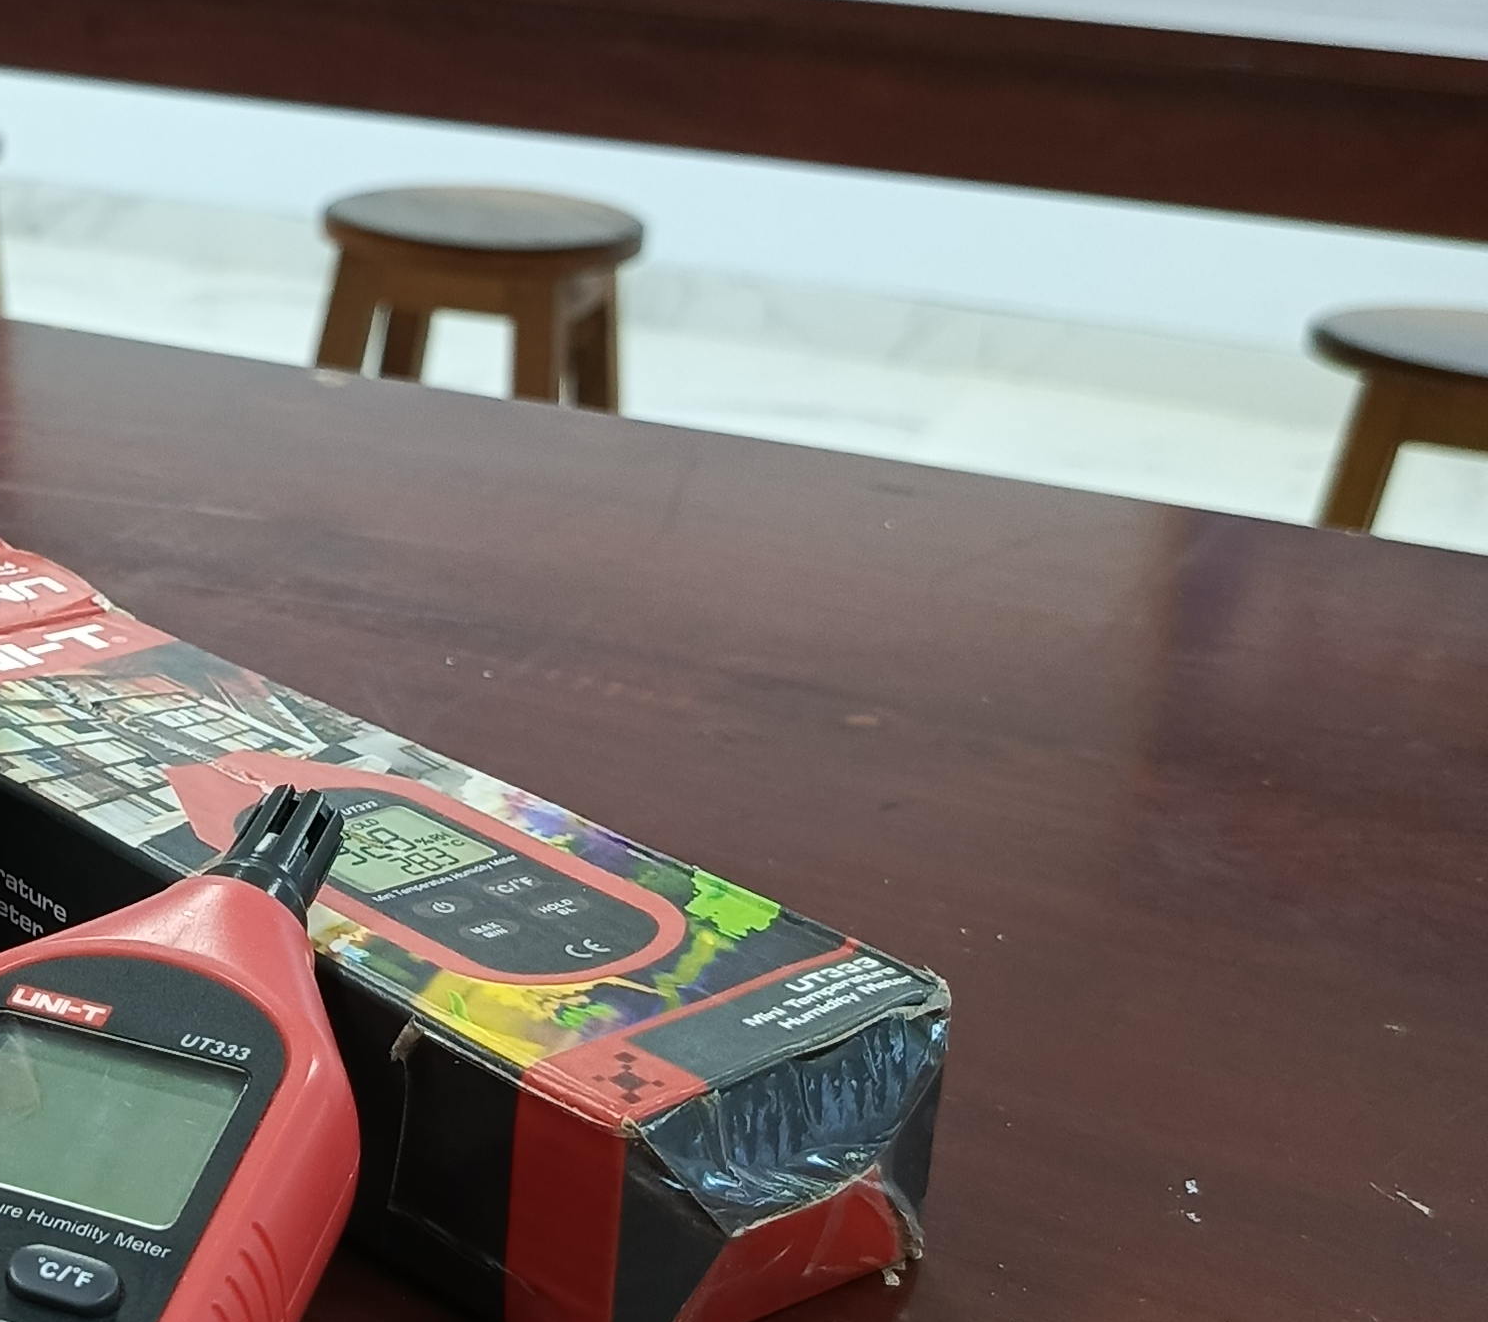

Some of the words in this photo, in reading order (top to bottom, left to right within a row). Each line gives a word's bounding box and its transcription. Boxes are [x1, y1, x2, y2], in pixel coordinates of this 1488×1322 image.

[785, 956, 880, 992] UT333
[11, 988, 107, 1023] UNI-T
[741, 1006, 788, 1028] Mini
[782, 966, 897, 1009] Temperature
[777, 992, 861, 1031] Humidity
[856, 975, 913, 996] Meter
[179, 1032, 251, 1062] UT333
[26, 1207, 111, 1245] Humidity
[113, 1229, 172, 1260] Meter
